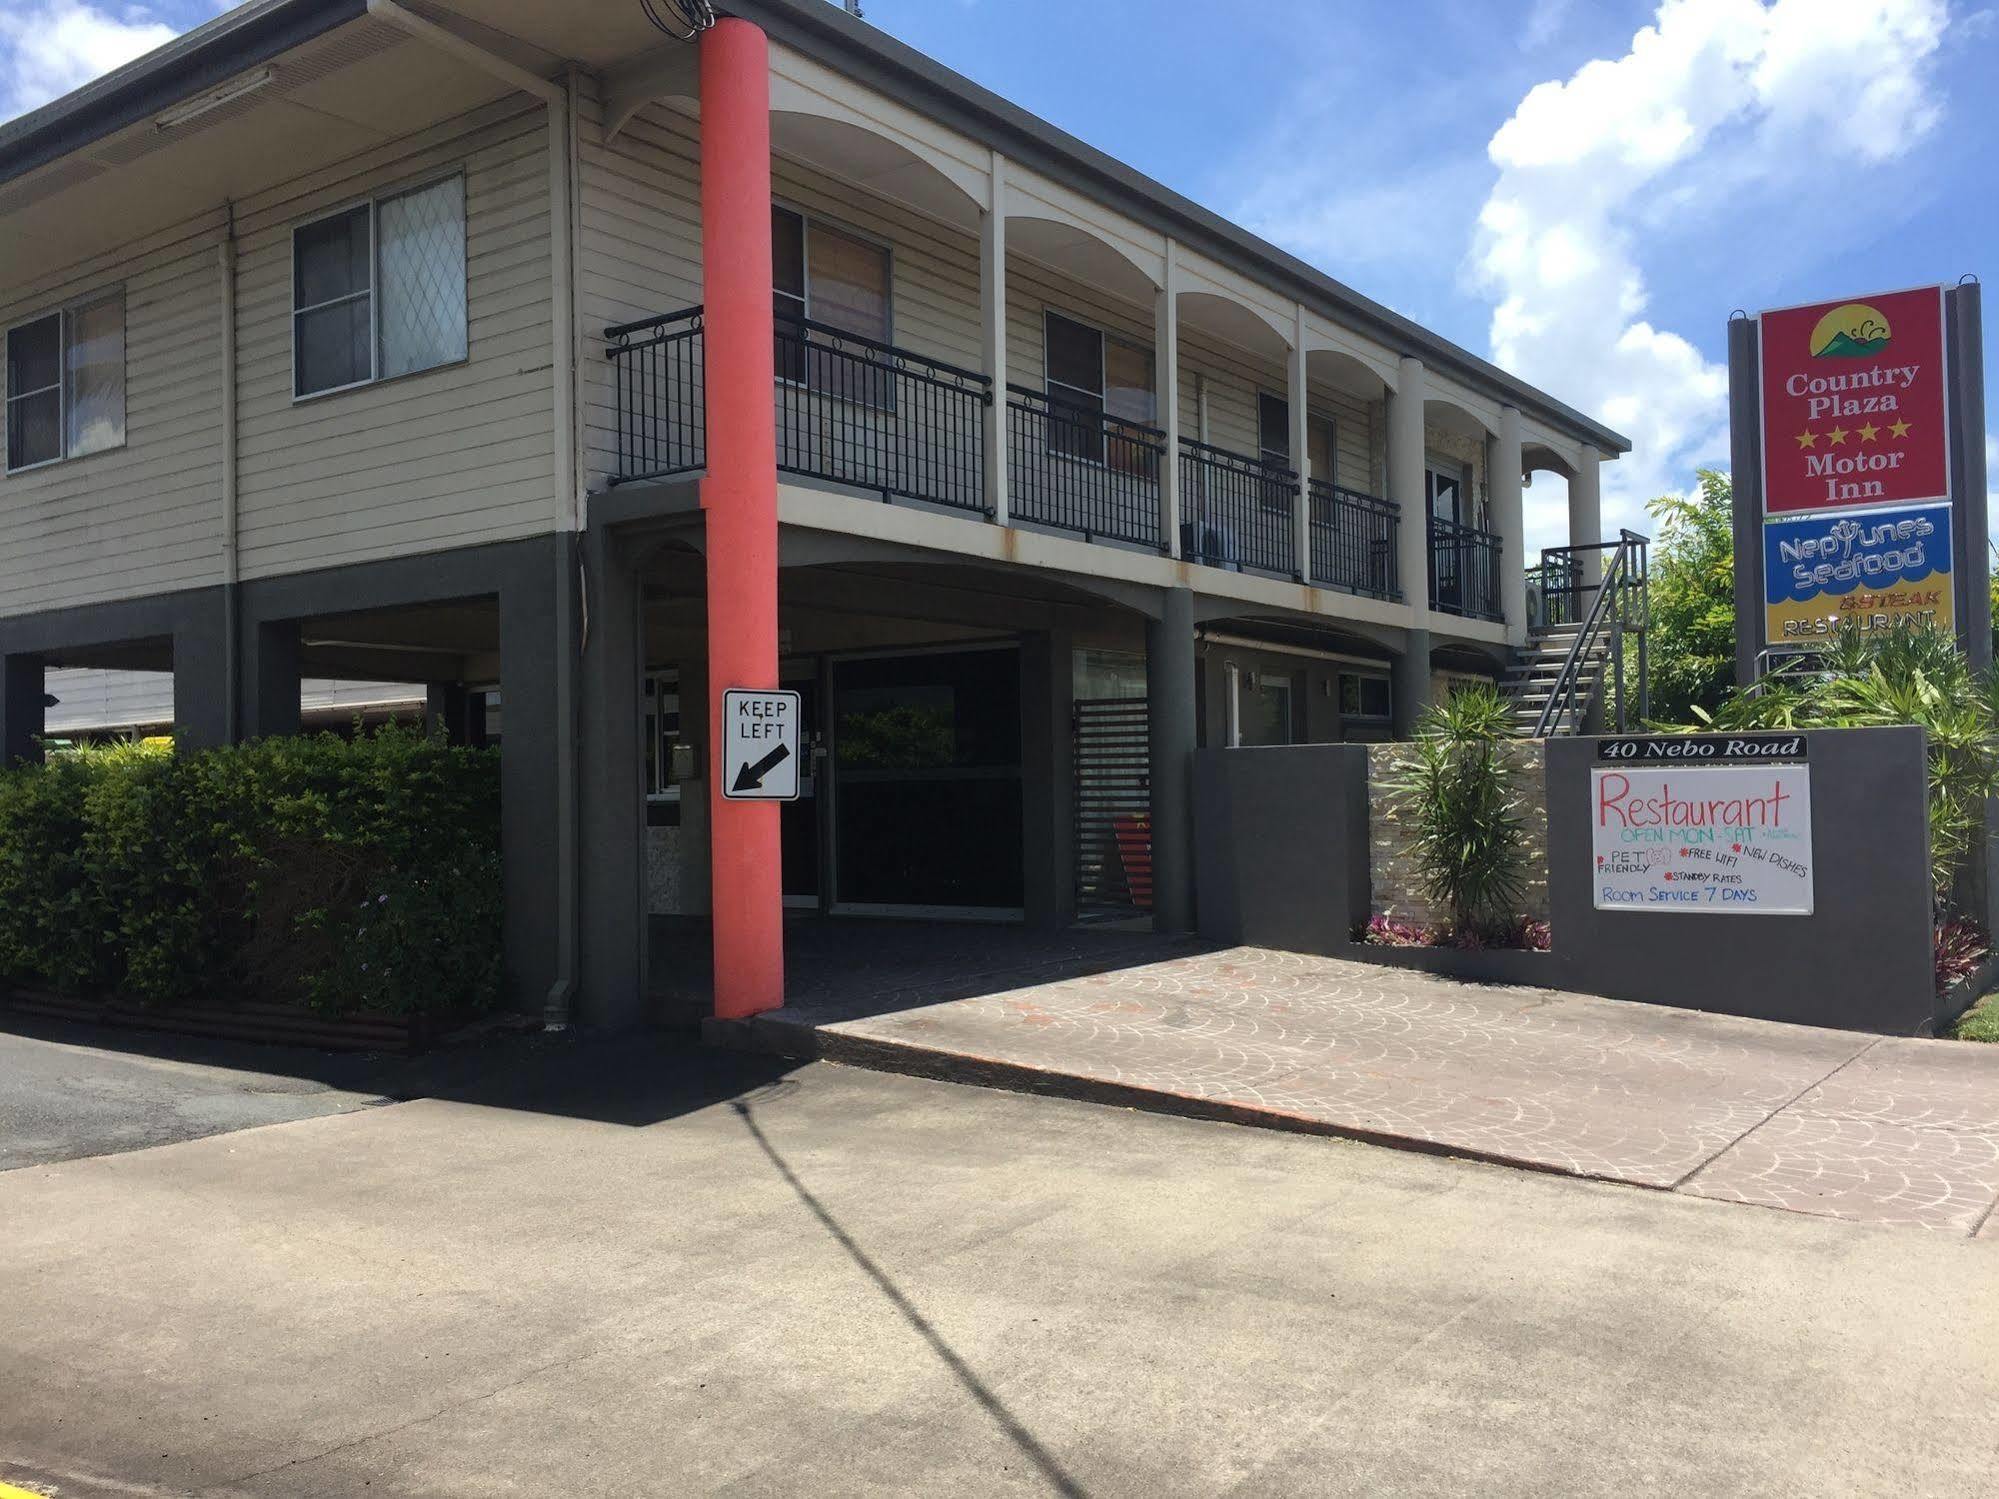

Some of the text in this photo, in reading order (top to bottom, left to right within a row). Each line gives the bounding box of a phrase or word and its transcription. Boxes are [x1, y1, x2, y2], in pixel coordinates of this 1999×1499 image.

[1786, 365, 1920, 396] Country
[1808, 394, 1898, 420] Plaza
[1806, 451, 1904, 477] Motor
[1826, 479, 1884, 501] Inn
[1780, 517, 1934, 563] Neptunes
[1793, 541, 1924, 589] Seafood
[739, 701, 787, 717] KEEP
[741, 723, 785, 739] LEFT
[1604, 738, 1800, 758] 40 Nebo Road
[1600, 773, 1790, 827] Restaurant
[1620, 827, 1664, 843] OPEN
[1611, 851, 1646, 863] PET
[1688, 848, 1739, 868] FREE WIFI
[1743, 846, 1808, 878] NEW DISHES
[1597, 863, 1651, 875] FRIENDLY
[1672, 872, 1743, 884] STANDBY RATES
[1704, 887, 1717, 902] 7
[1722, 888, 1758, 902] DAYS
